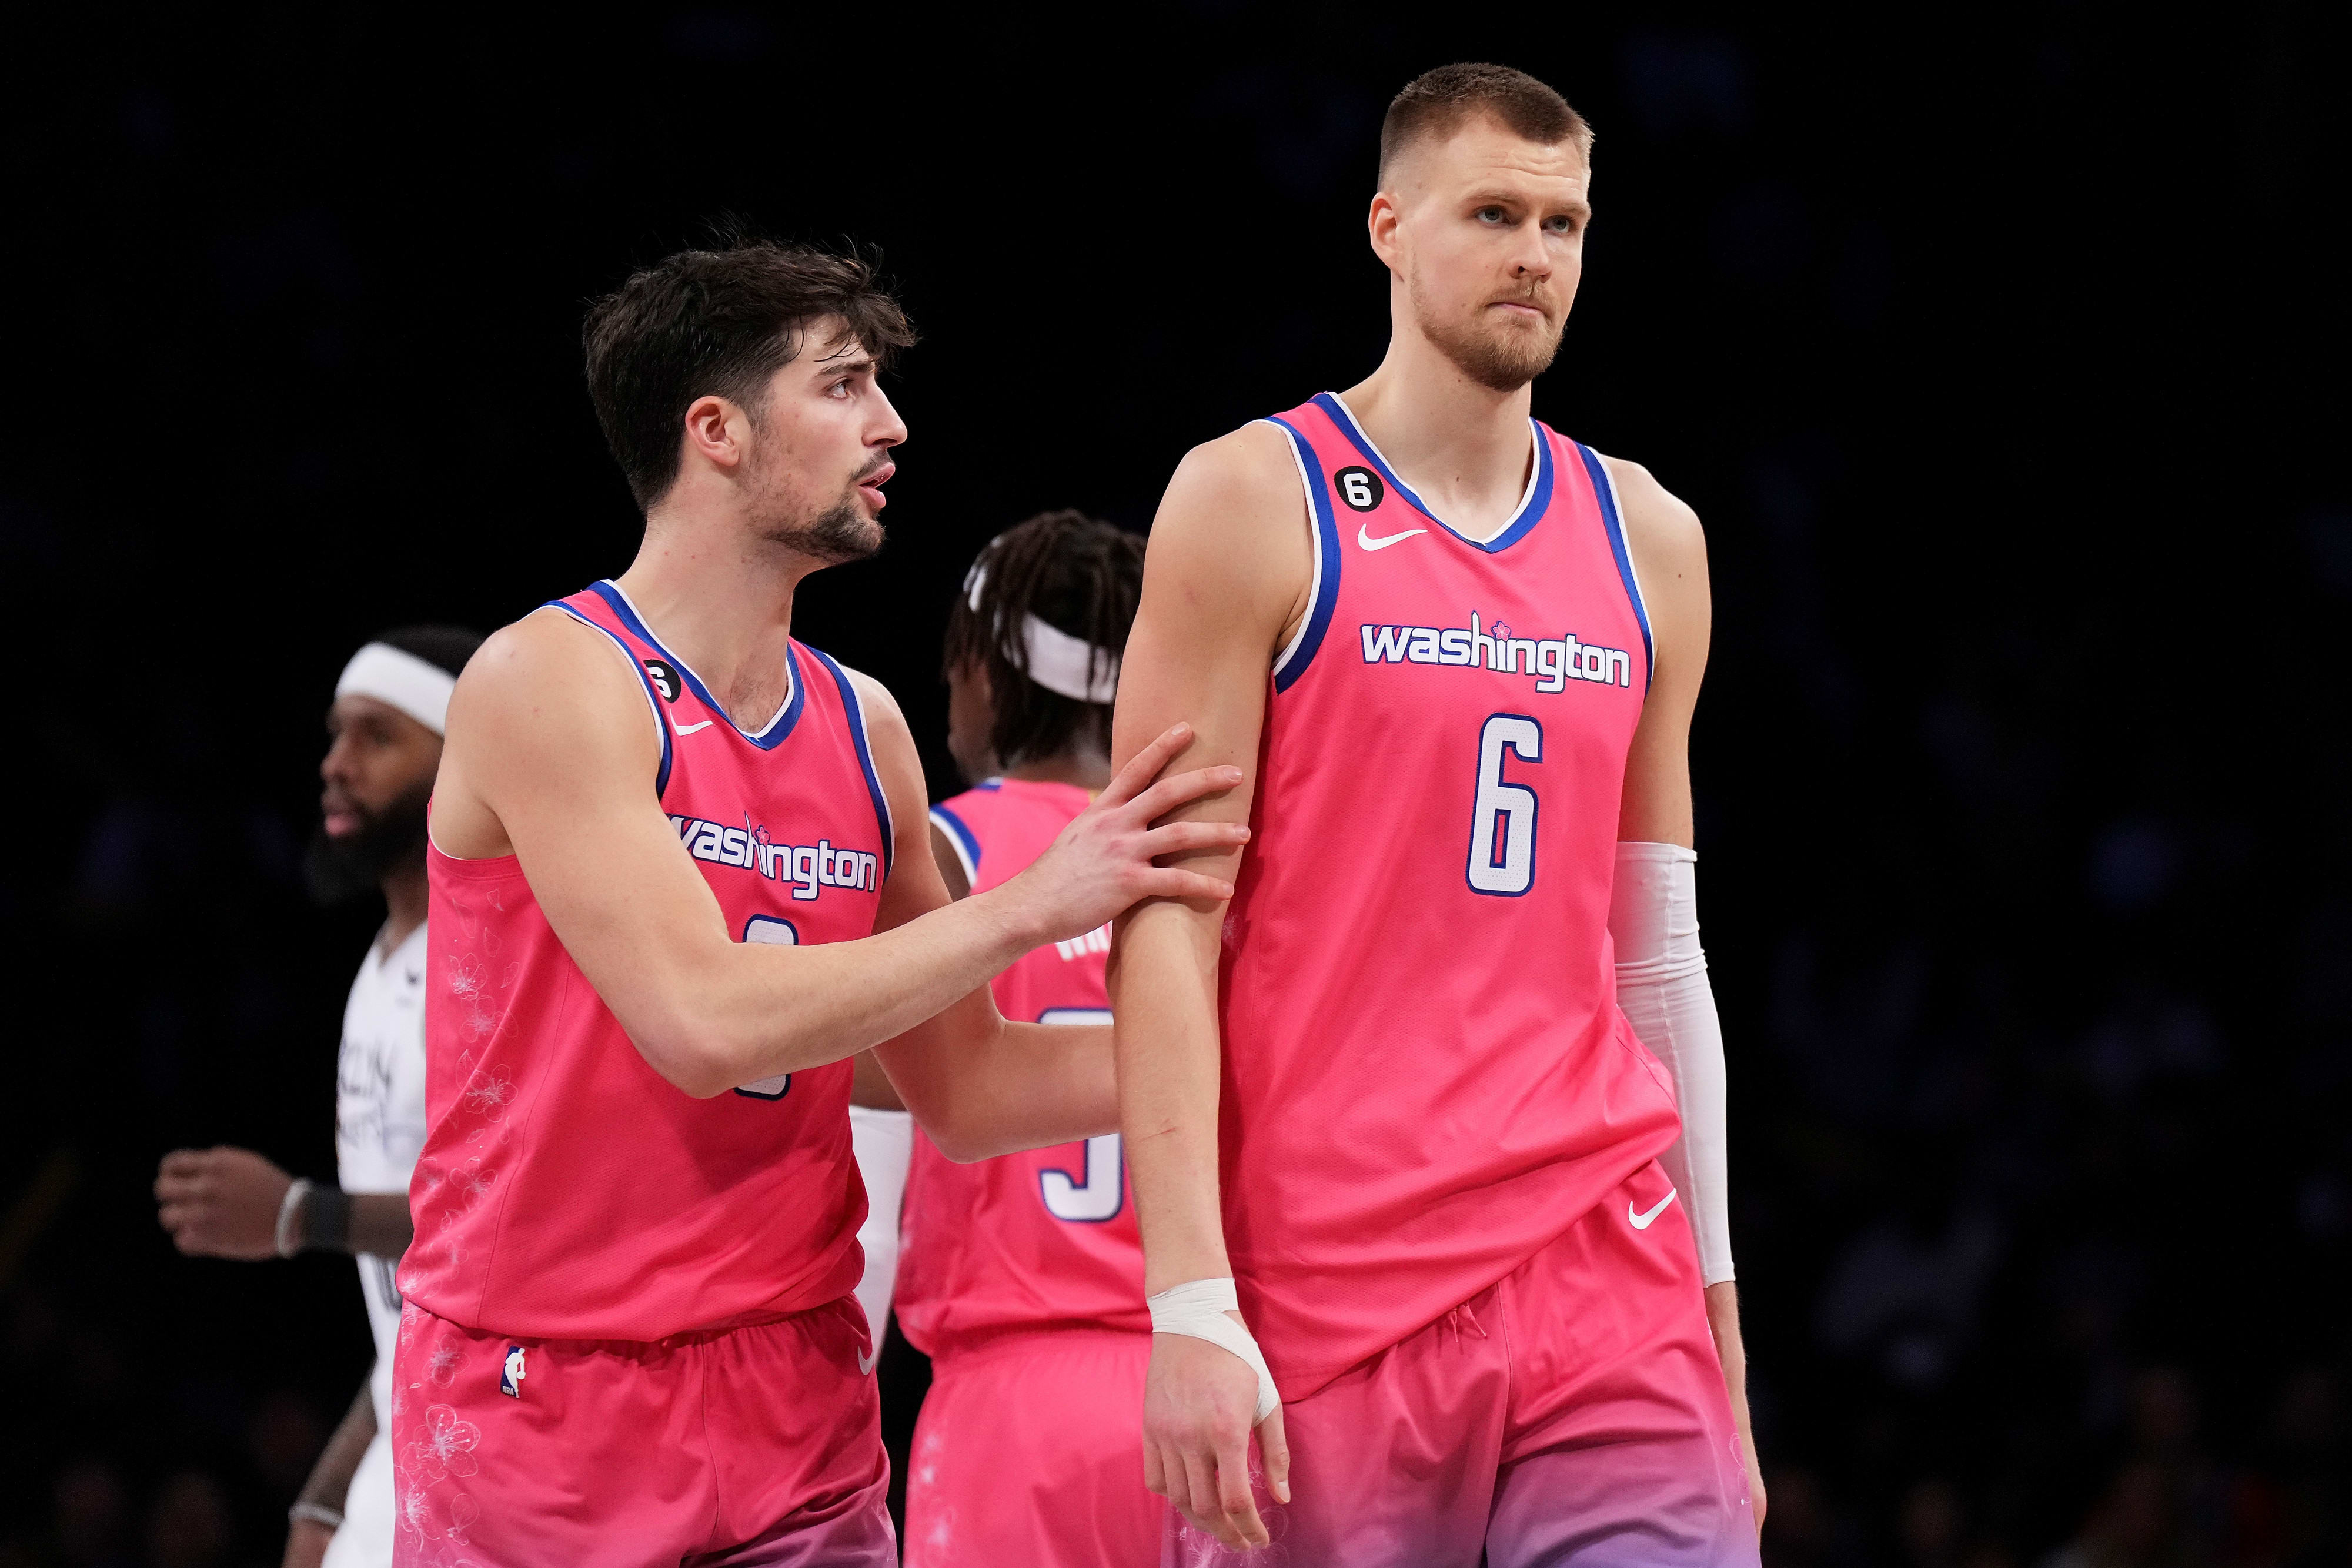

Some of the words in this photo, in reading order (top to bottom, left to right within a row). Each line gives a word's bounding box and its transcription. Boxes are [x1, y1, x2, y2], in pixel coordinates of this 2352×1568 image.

[1343, 473, 1372, 506] 6
[1360, 609, 1631, 694] washington
[1465, 712, 1544, 897] 6
[502, 1385, 514, 1396] NBA
